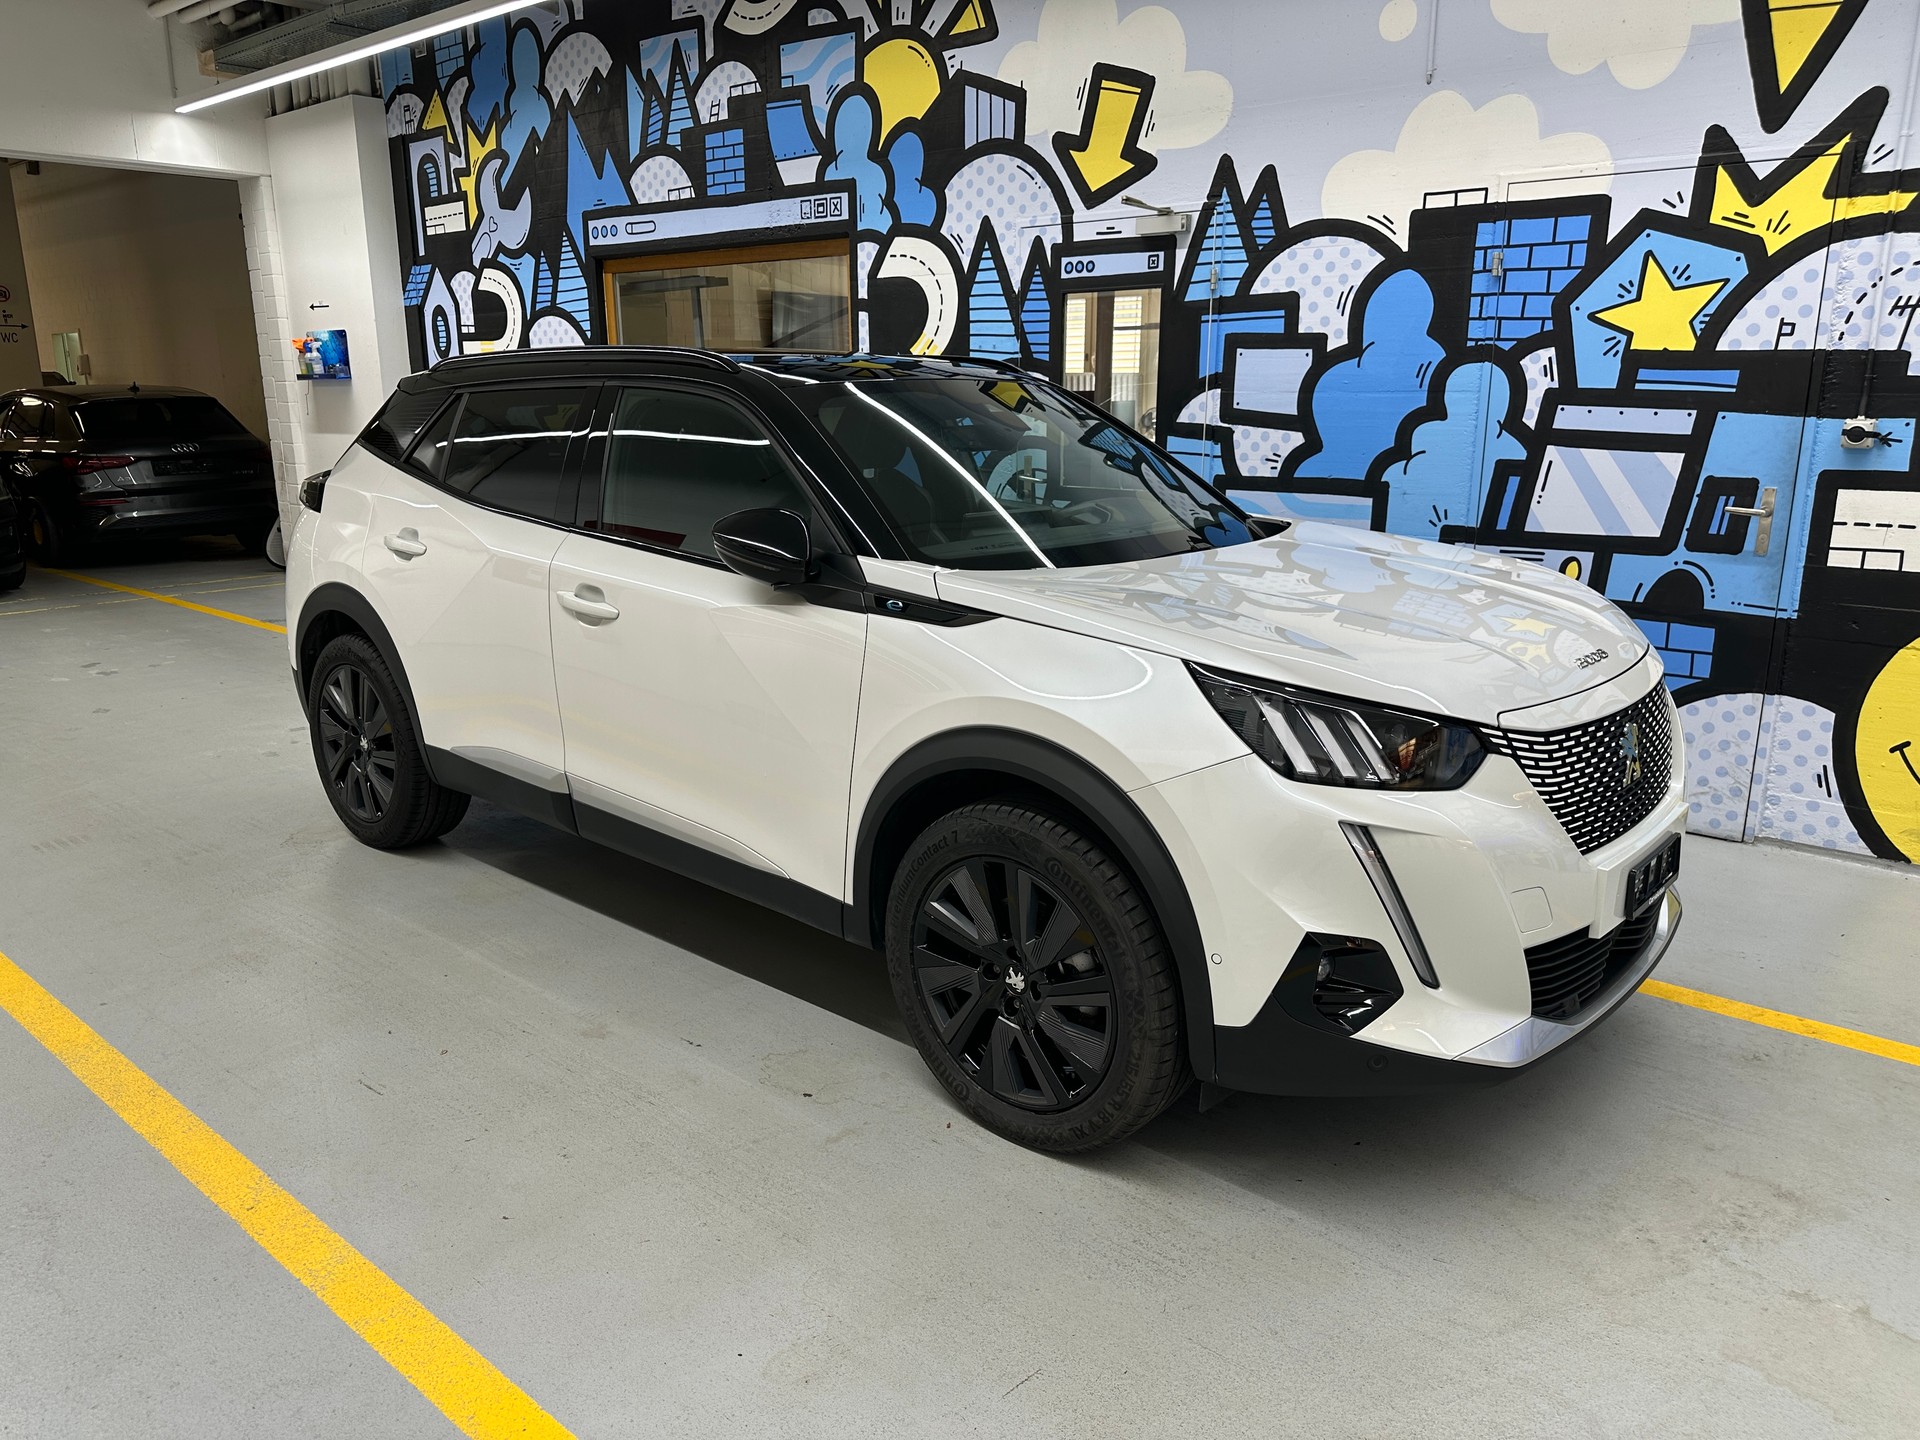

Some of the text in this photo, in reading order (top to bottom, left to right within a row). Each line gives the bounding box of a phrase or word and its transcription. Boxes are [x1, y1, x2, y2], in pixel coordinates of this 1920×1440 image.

[1, 332, 18, 343] WC
[890, 829, 960, 929] PremiumContact 7
[1043, 854, 1125, 958] Continental
[1115, 1049, 1142, 1100] 215/55
[1097, 1106, 1115, 1125] 18
[1107, 1097, 1122, 1112] R
